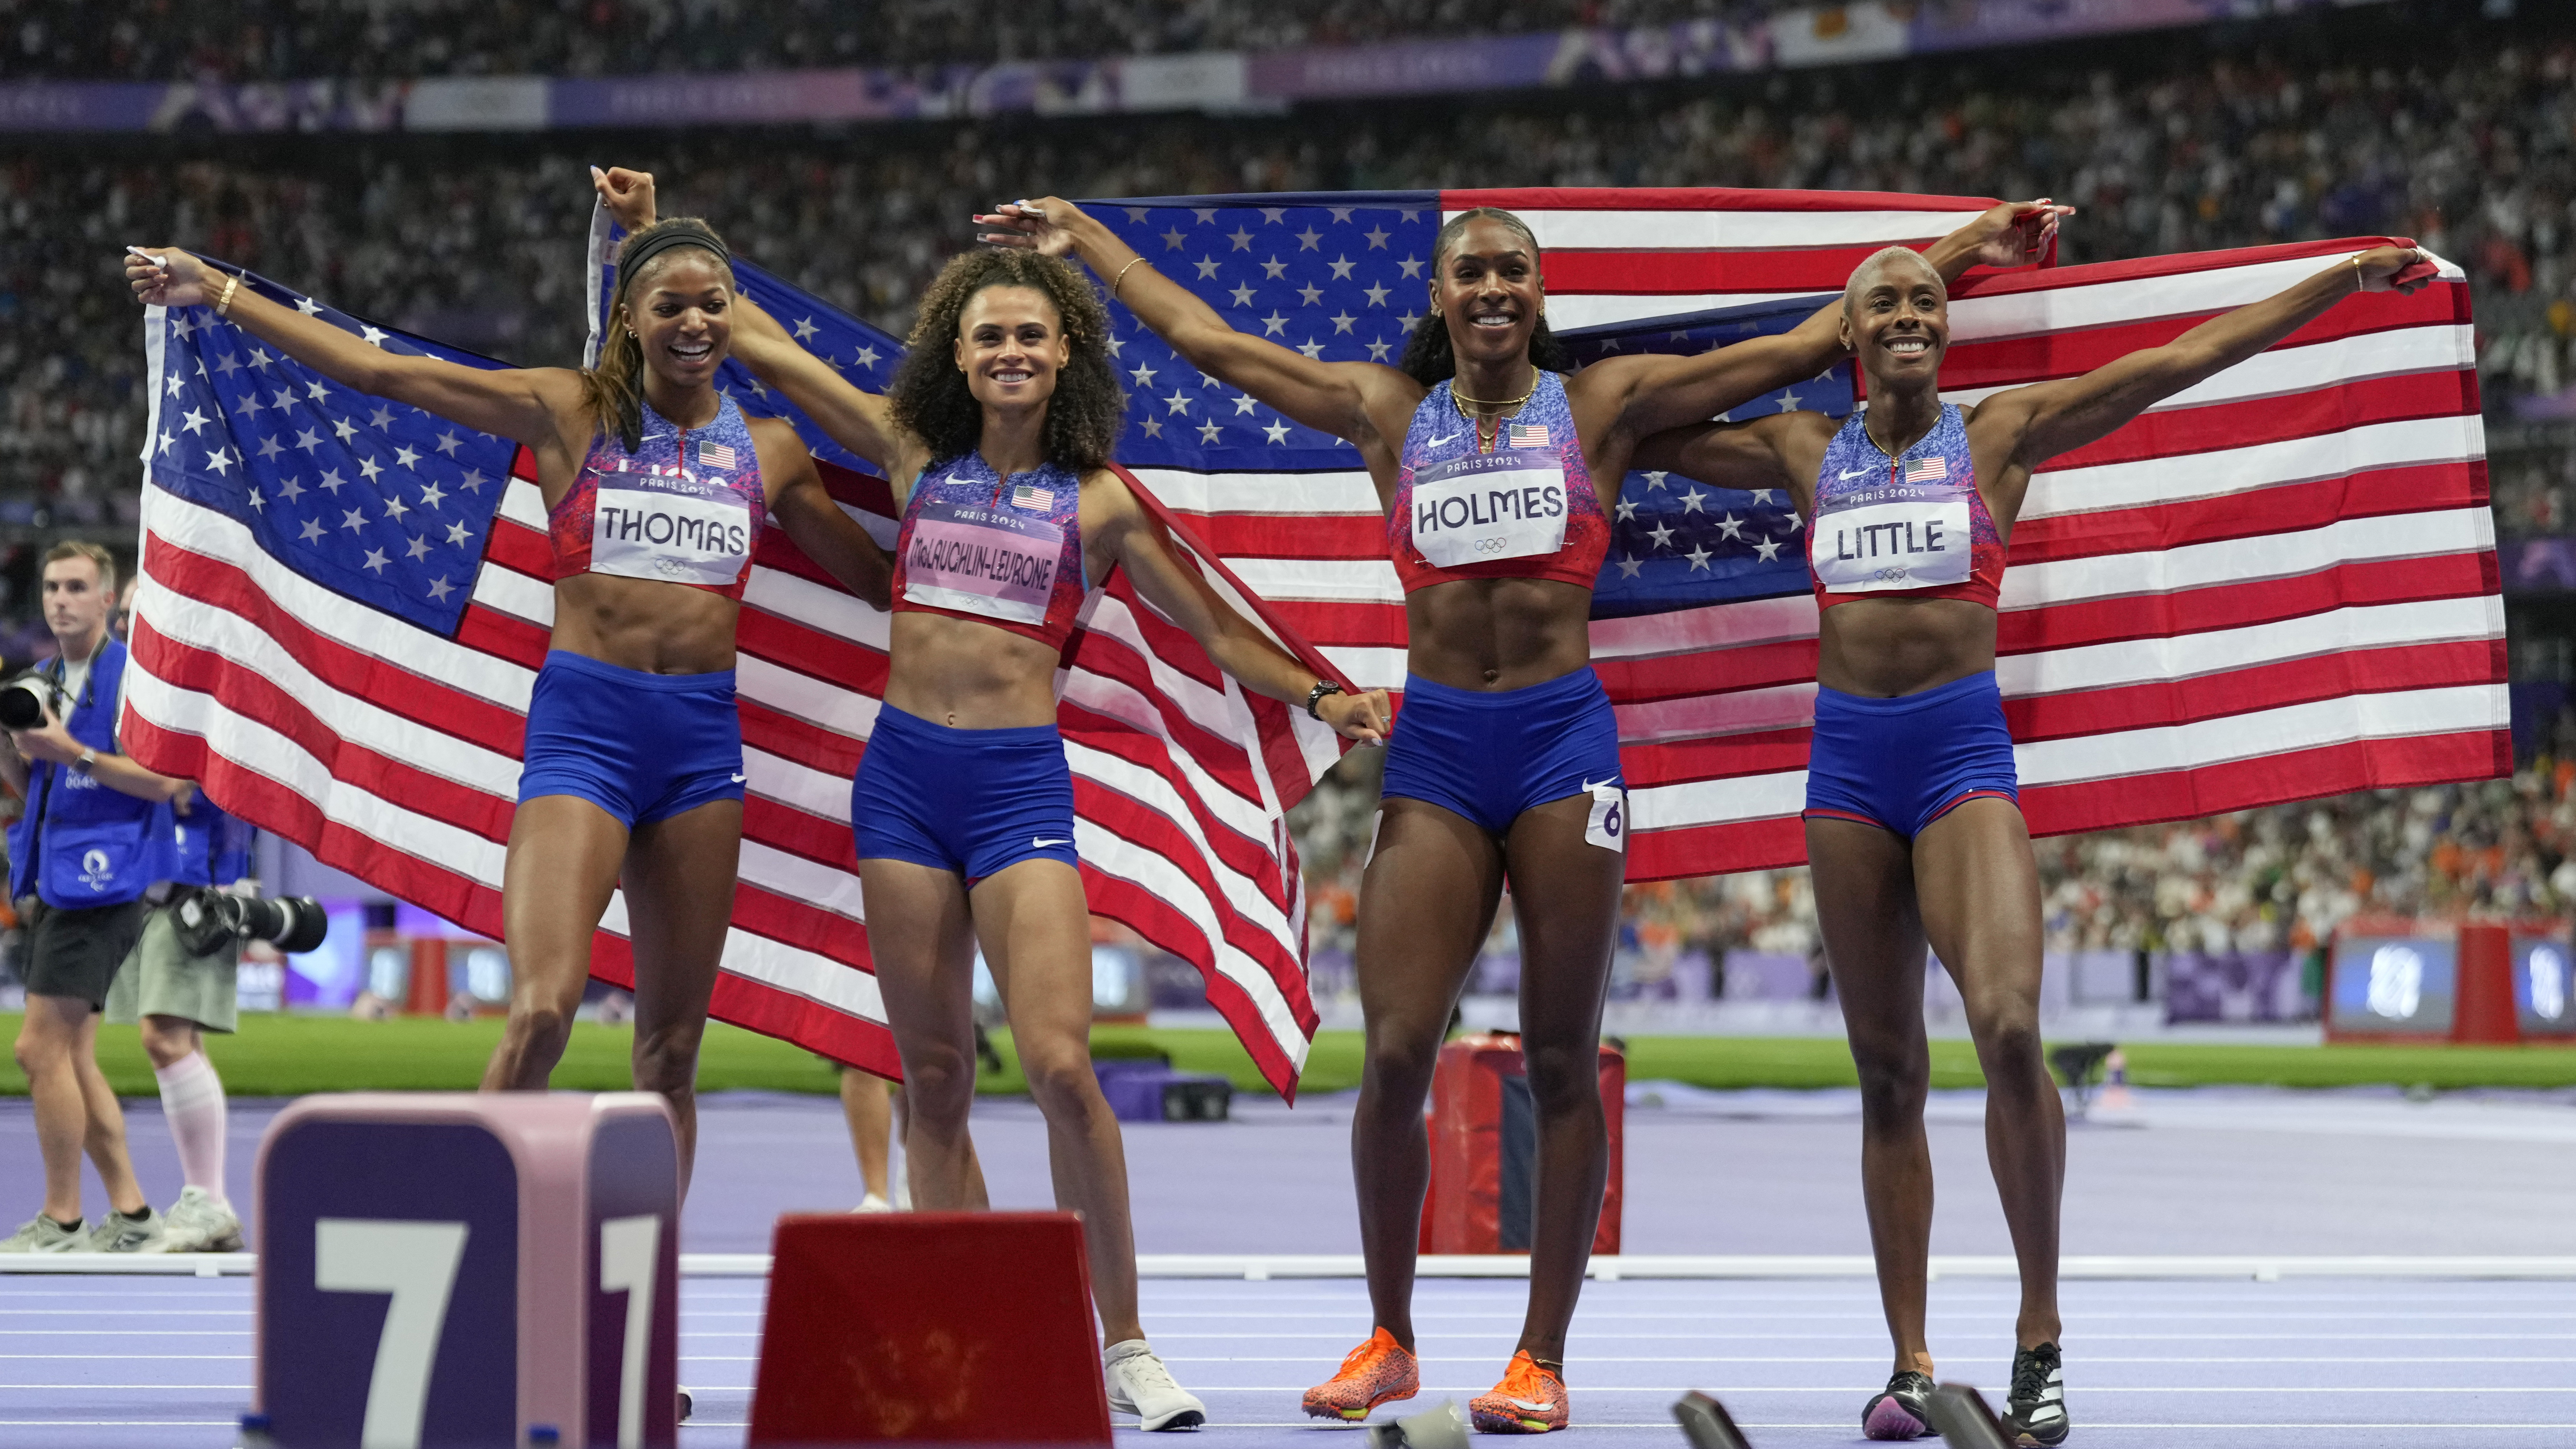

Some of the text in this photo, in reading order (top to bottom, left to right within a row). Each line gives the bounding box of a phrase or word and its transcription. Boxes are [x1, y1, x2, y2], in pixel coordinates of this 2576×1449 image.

[1447, 456, 1521, 474] PARIS 2024
[640, 477, 713, 496] PARIS 2024
[1850, 489, 1925, 504] PARIS 2024
[954, 510, 1024, 530] PARIS 2024
[1418, 486, 1563, 534] HOLMES
[601, 507, 744, 555] THOMAS
[1838, 520, 1945, 560] LITTLE
[1603, 801, 1621, 837] 6
[314, 1217, 471, 1449] 7
